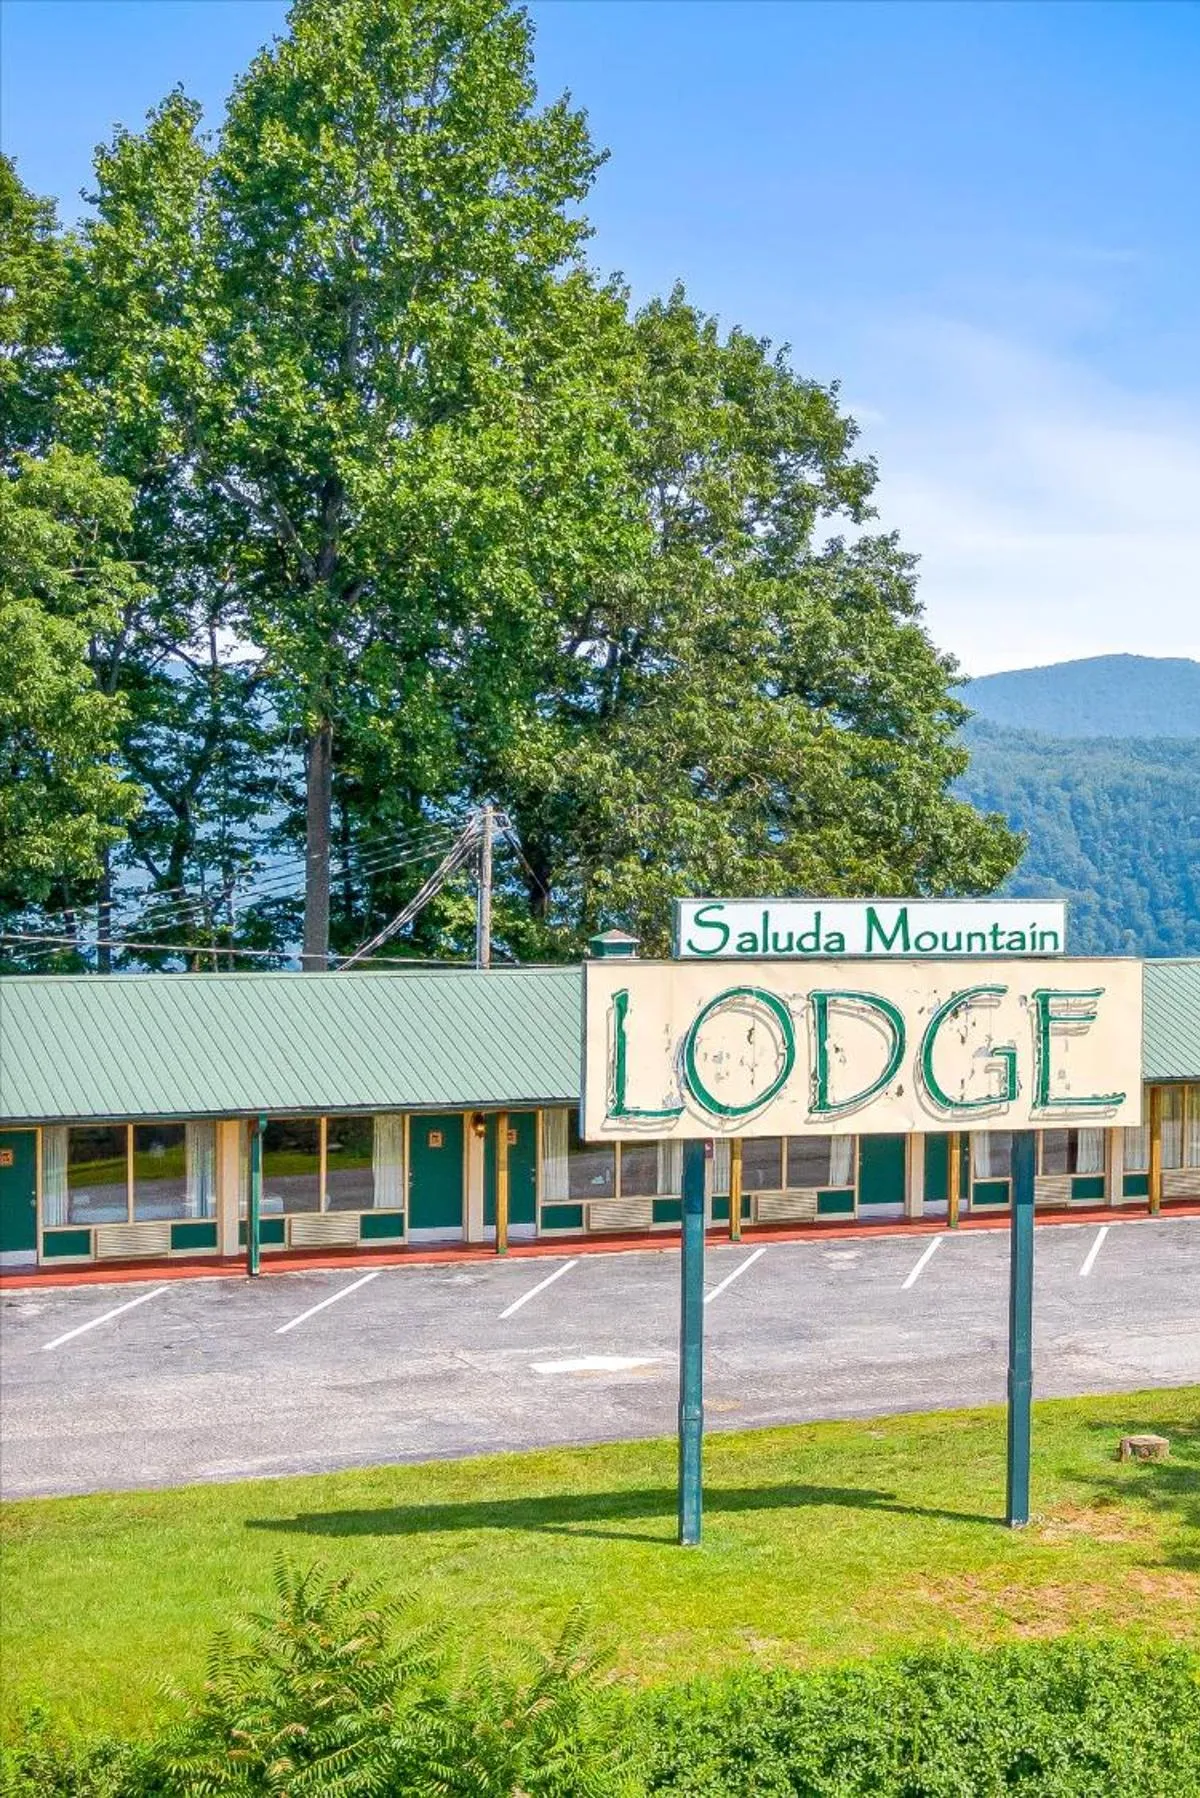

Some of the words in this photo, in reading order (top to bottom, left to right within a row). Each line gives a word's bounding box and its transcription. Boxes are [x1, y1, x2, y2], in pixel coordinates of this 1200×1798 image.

[686, 904, 845, 955] Saluda
[865, 906, 1060, 953] Mountain
[605, 983, 1127, 1120] LODGE
